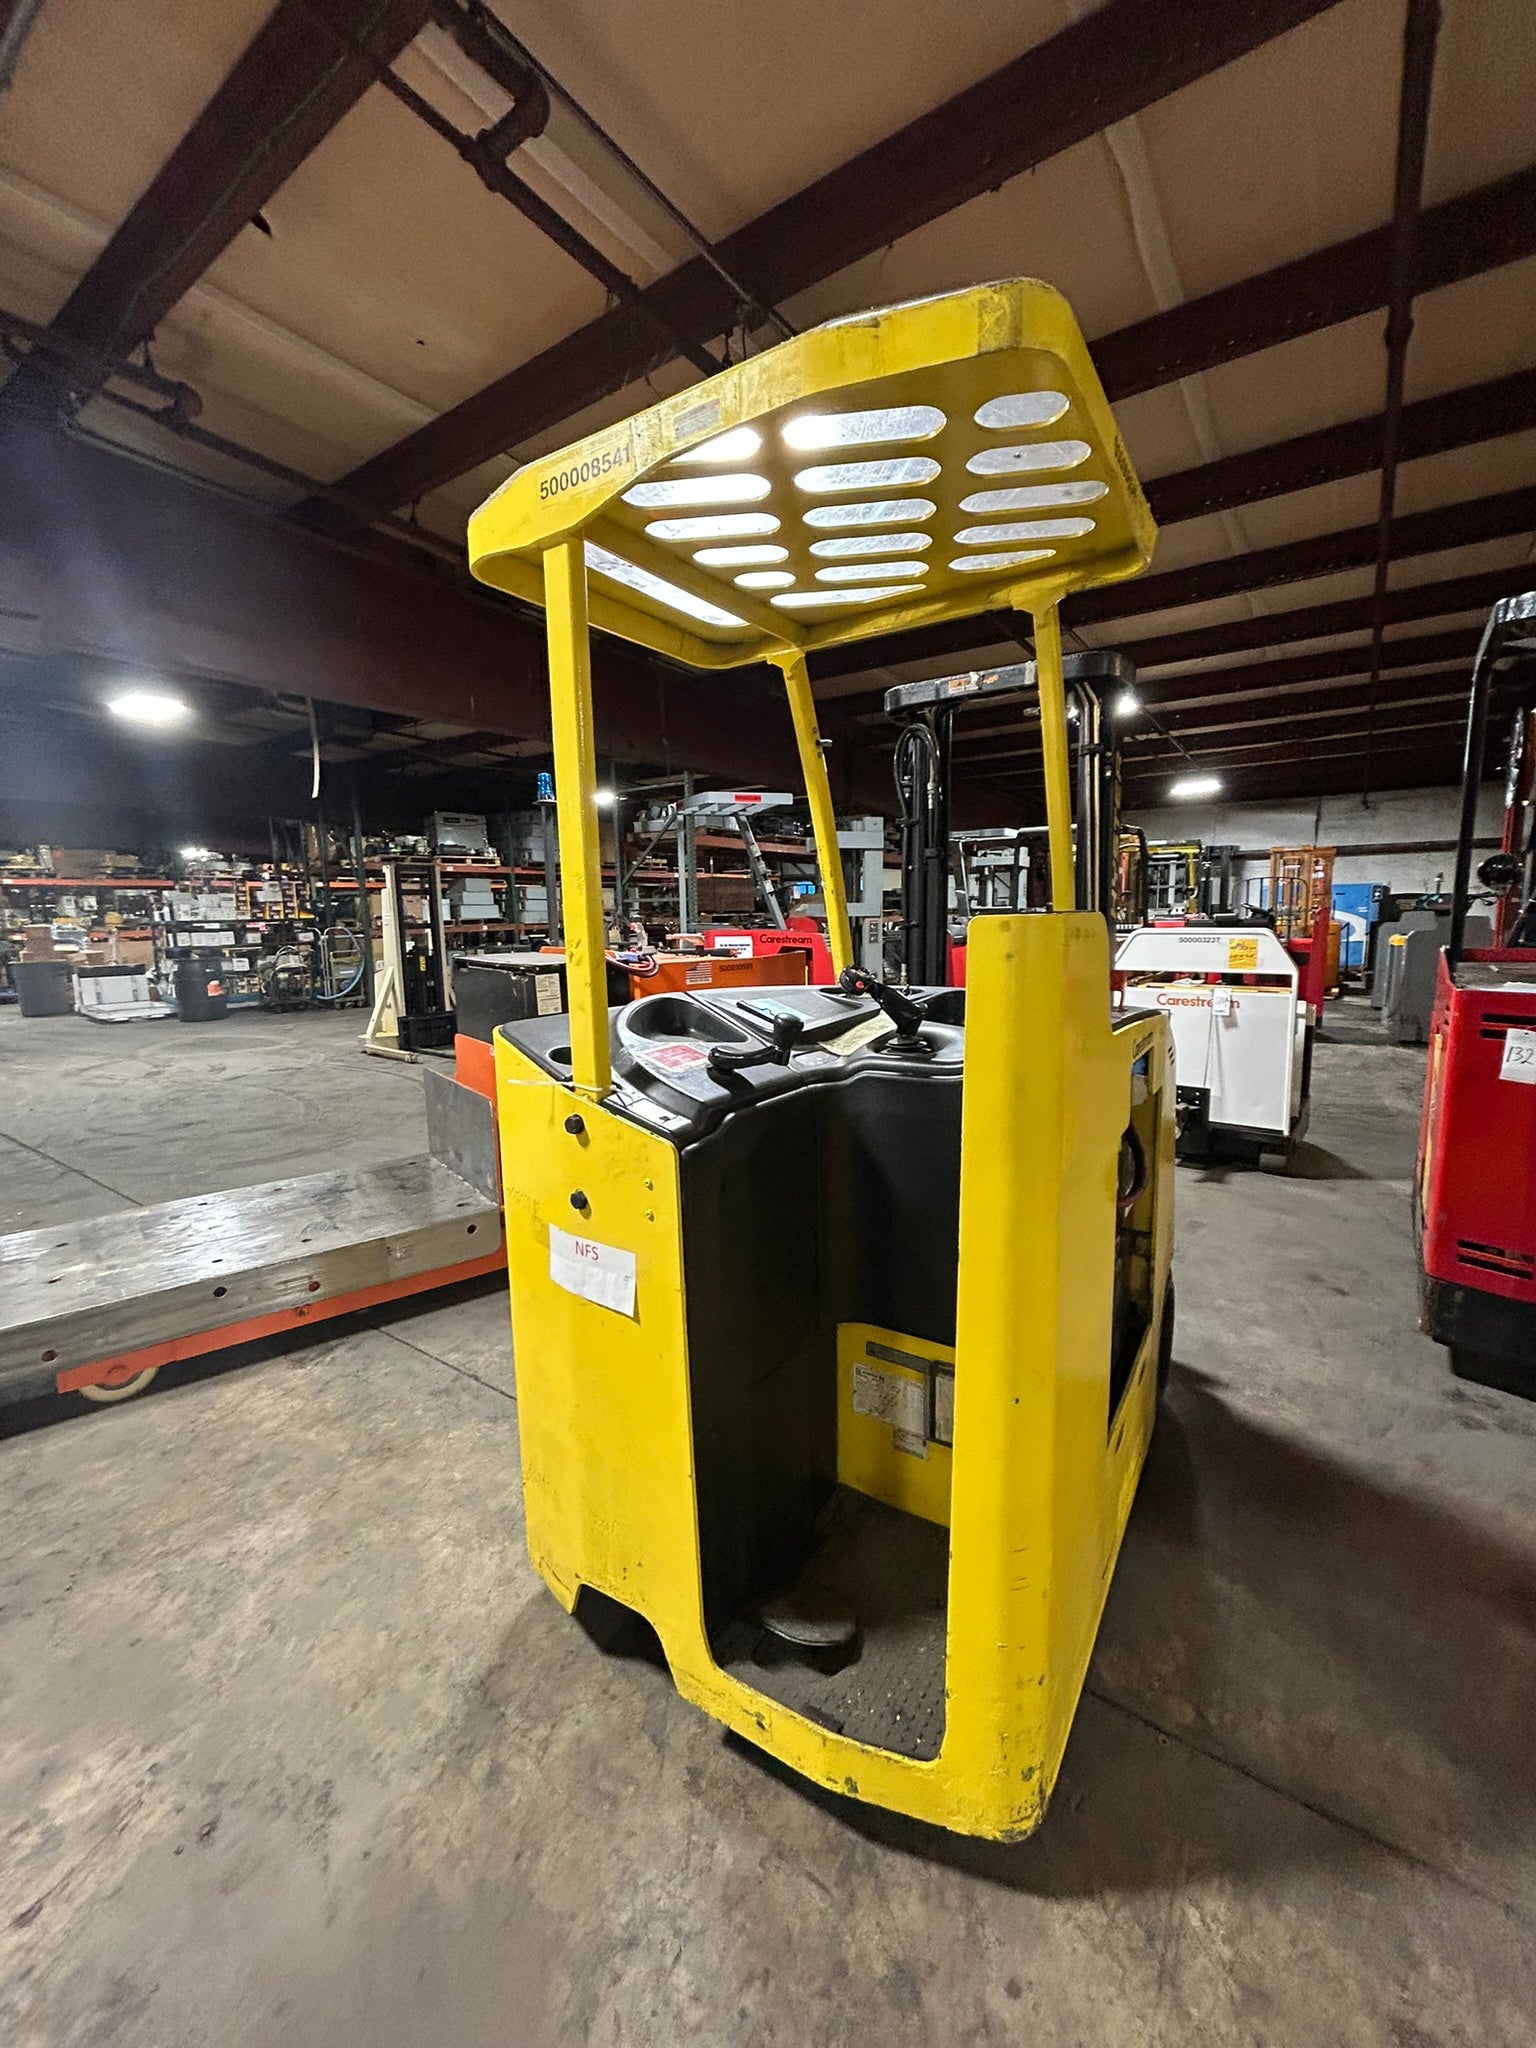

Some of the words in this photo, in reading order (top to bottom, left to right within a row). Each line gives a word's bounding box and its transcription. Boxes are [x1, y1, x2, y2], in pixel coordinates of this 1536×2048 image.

[540, 442, 630, 501] 500008541
[759, 933, 813, 944] Carestream
[1156, 993, 1241, 1009] Carestrem
[575, 1240, 600, 1261] NFS
